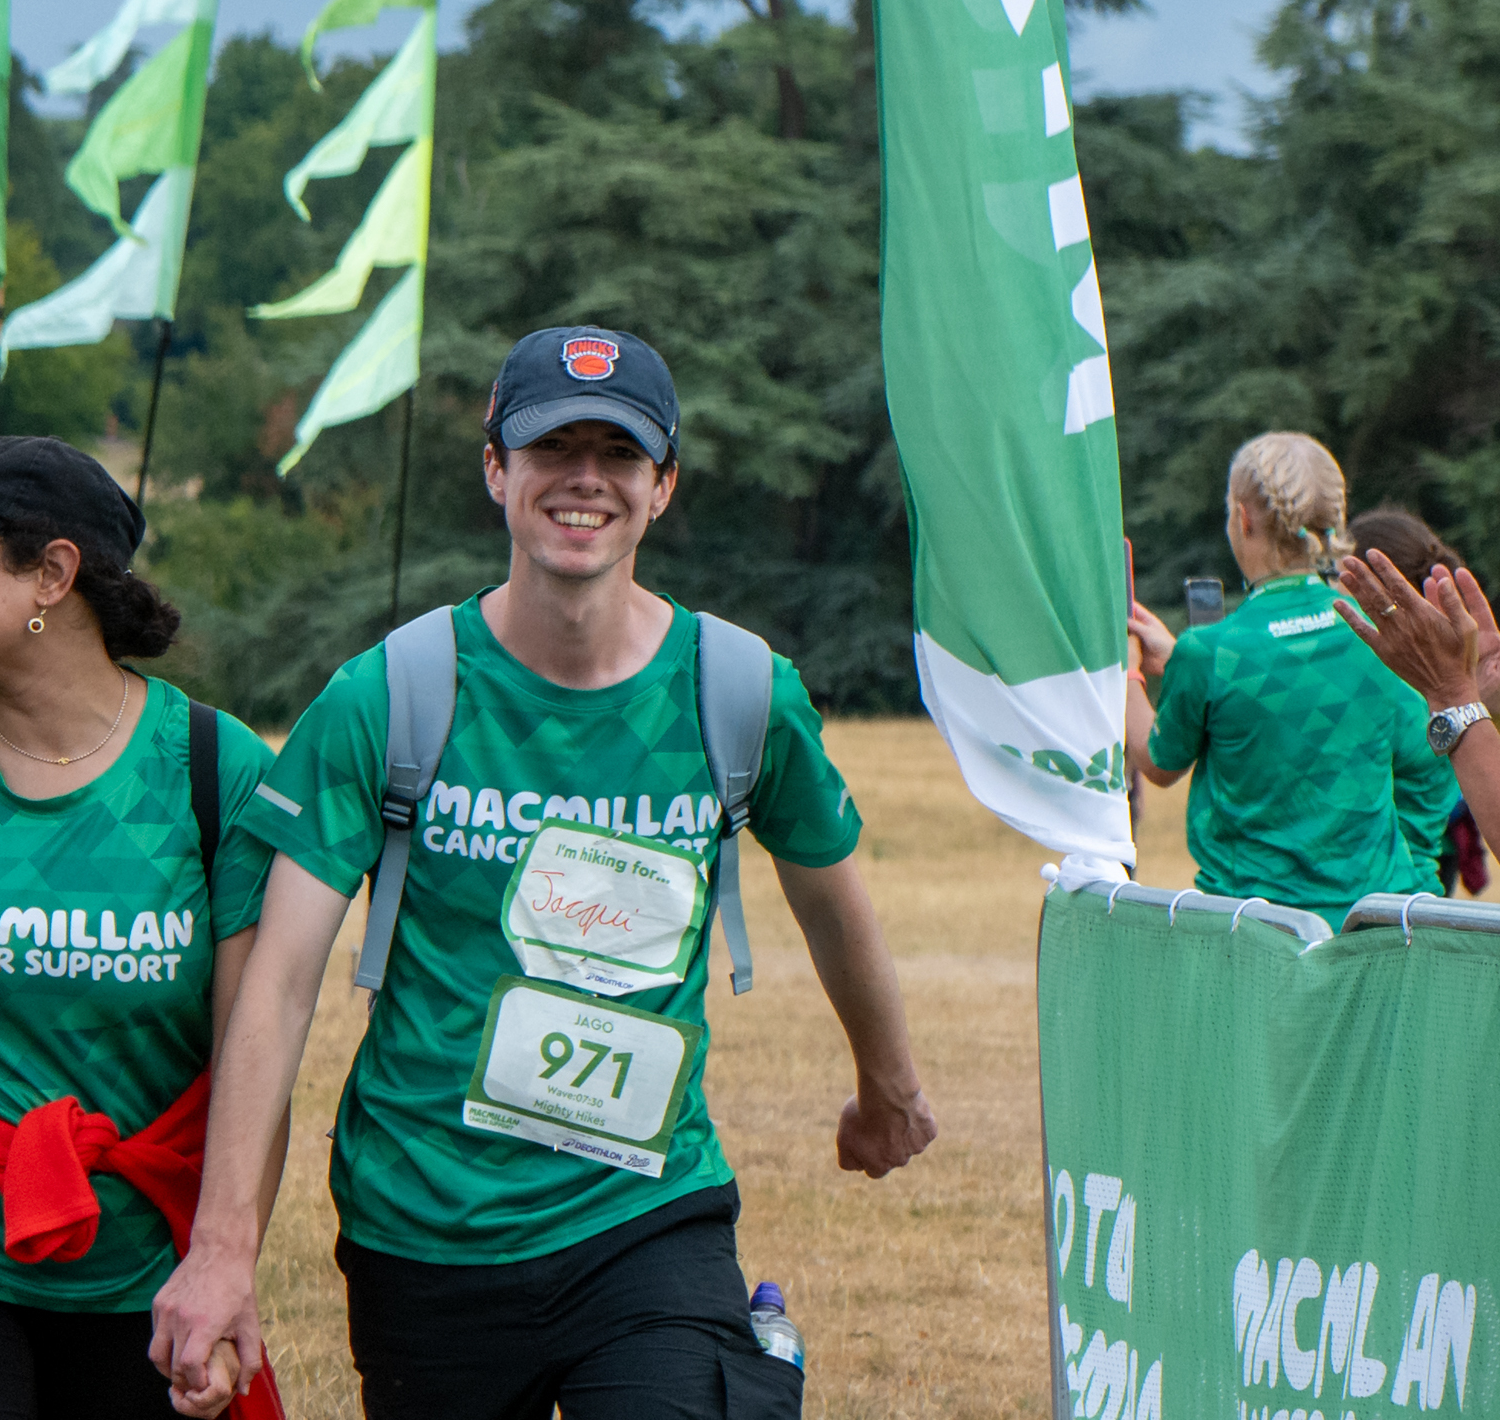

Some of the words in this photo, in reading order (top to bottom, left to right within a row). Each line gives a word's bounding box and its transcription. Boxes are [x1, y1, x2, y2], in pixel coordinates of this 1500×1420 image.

[566, 341, 614, 357] KNICKS
[555, 843, 577, 860] I'm
[579, 850, 627, 873] hiking
[531, 870, 632, 936] Jacqui
[24, 949, 181, 982] SUPPORT
[574, 1014, 614, 1034] JAGO
[538, 1032, 633, 1099] 971
[547, 1085, 604, 1108] Wave:07:30
[533, 1099, 573, 1120] Mighty
[576, 1110, 606, 1127] Hikes
[575, 1141, 622, 1161] DECATHLON
